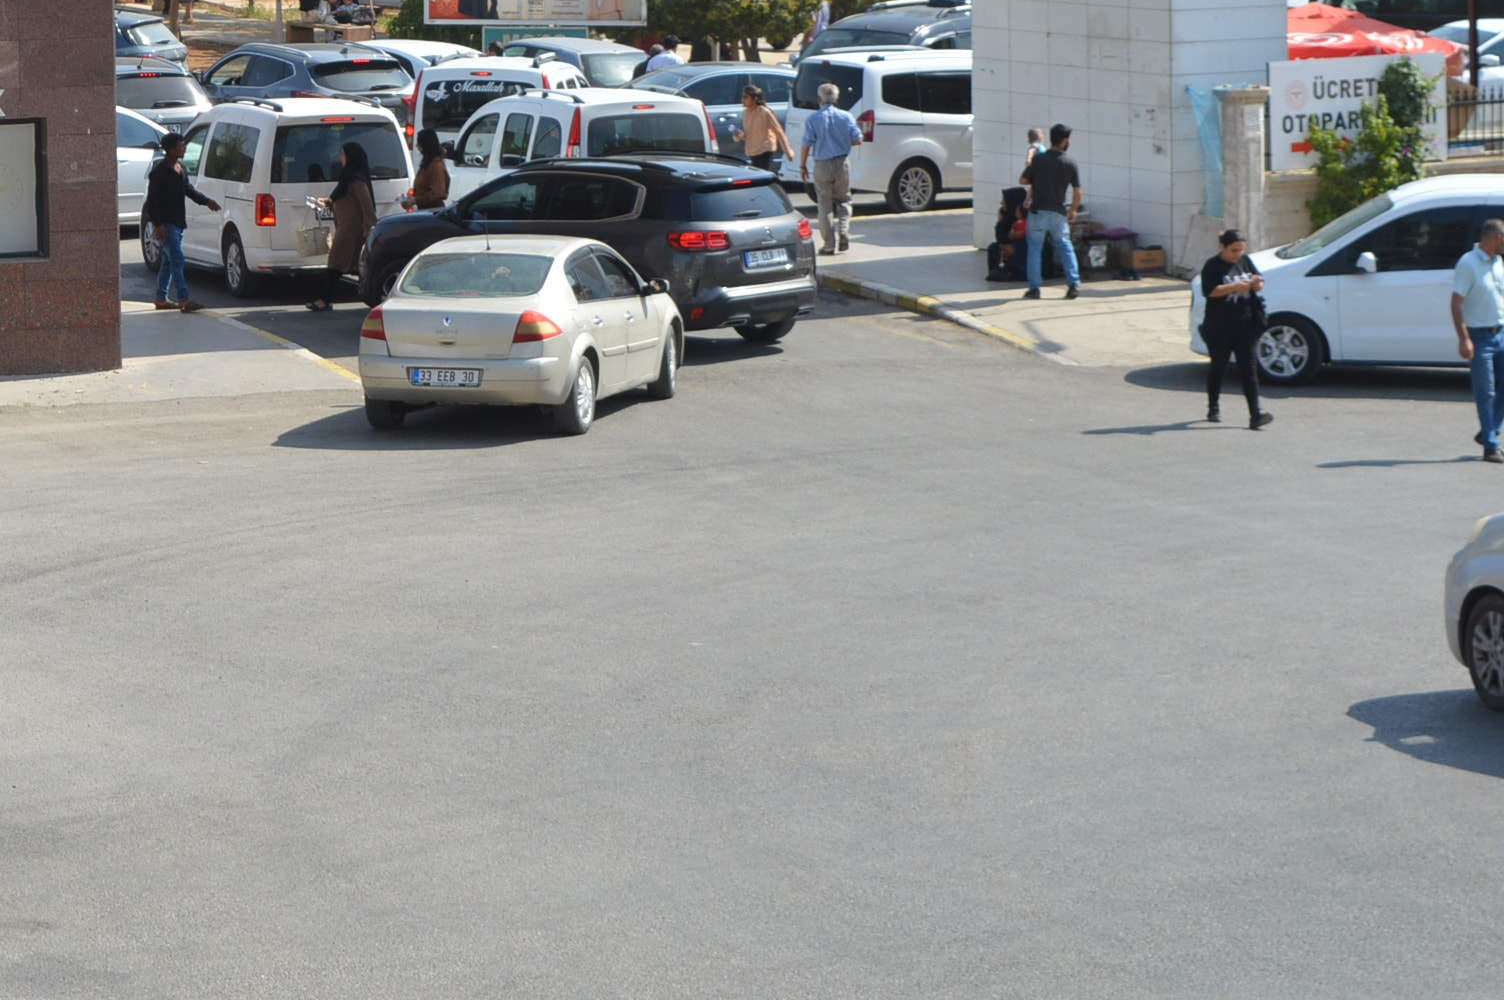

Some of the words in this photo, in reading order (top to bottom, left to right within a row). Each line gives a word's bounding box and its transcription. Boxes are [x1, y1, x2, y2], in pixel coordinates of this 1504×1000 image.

[420, 370, 432, 381] 33
[437, 370, 456, 382] EEB
[462, 371, 475, 382] 30
